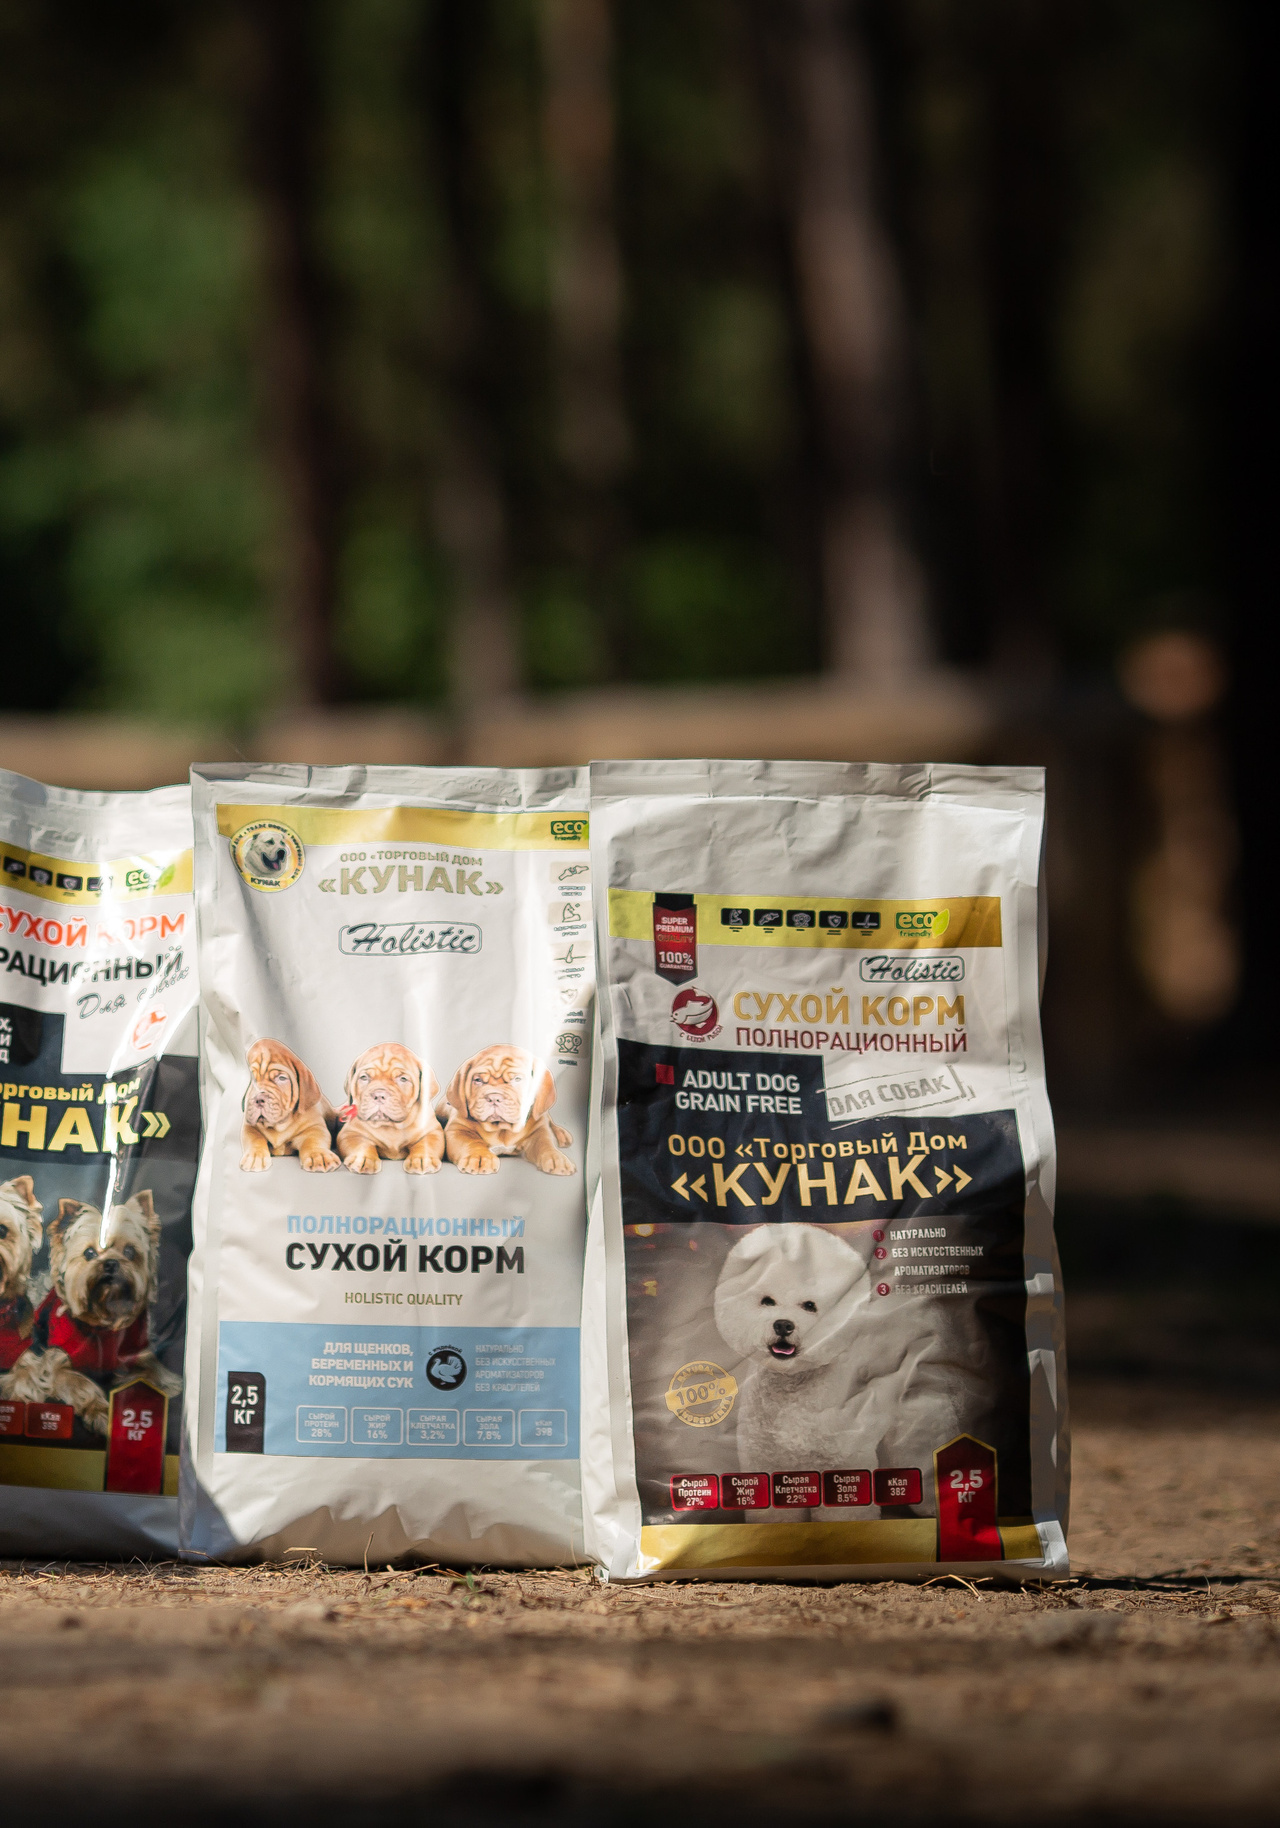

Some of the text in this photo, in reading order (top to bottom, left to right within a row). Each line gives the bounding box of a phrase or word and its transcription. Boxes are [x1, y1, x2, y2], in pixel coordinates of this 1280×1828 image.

[552, 821, 585, 835] eco
[340, 852, 367, 863] ООО
[451, 853, 483, 867] ДОМ
[318, 865, 504, 896] «КУНАК»
[661, 916, 689, 925] SUPER
[897, 913, 934, 928] eco
[655, 924, 694, 934] PREMIUM
[898, 929, 932, 939] friendly
[348, 922, 477, 953] Holistic
[657, 933, 695, 944] QUALITY
[658, 951, 694, 965] 100%
[865, 955, 962, 982] Holistic
[732, 986, 966, 1027] СУХОЙ КОРМ
[0, 1034, 12, 1047] И
[735, 1026, 968, 1055] ПОЛНОРАЦИОННЫЙ
[682, 1069, 800, 1094] ADULT DOG
[97, 1077, 142, 1106] Дом
[876, 1074, 952, 1103] СОБАК
[674, 1092, 803, 1116] GRAIN FREE
[667, 1131, 969, 1165] ООО «Торговый Дом
[670, 1154, 974, 1208] «КУНАК»
[286, 1214, 526, 1240] ПОЛНОРАЦИОННЫЙ
[889, 1227, 947, 1241] НАТУРАЛЬНО
[285, 1238, 525, 1274] СУХОЙ КОРМ
[891, 1246, 984, 1258] БЕЗ ИСКУССТВЕННЫХ
[894, 1264, 970, 1277] АРОМАТИЗАТОРОВ
[895, 1281, 969, 1296] БЕЗ КРАСИТЕЛЕЙ
[344, 1292, 463, 1307] HOLISTIC QUALITY
[323, 1341, 415, 1357] ДЛЯ ЩЕНКОВ,
[475, 1344, 525, 1354] НАТУРАЛЬНО
[311, 1357, 414, 1372] БЕРЕМЕННЫХ И
[475, 1357, 557, 1367] БЕЗ ИСКУССТВЕННЫХ
[475, 1370, 545, 1380] АРОМАТИЗАТОРОВ
[676, 1363, 716, 1384] NATURAL
[308, 1374, 414, 1390] КОРМЯЩИХ СУК
[475, 1383, 541, 1393] БЕЗ КРАСИТЕЛЕЙ
[230, 1384, 259, 1408] 2,5
[674, 1381, 726, 1406] 100%
[121, 1408, 154, 1430] 2,5
[233, 1409, 256, 1425] КГ
[307, 1412, 336, 1421] СЫРОЙ
[363, 1413, 391, 1422] СЫРОЙ
[419, 1415, 447, 1423] СЫРАЯ
[475, 1415, 503, 1423] СЫРАЯ
[304, 1420, 340, 1429] ПРОТЕИН
[367, 1422, 387, 1430] ЖИР
[410, 1422, 456, 1430] КЛЕТЧАТКА
[310, 1428, 333, 1438] 28%
[366, 1429, 388, 1440] 16%
[535, 1427, 553, 1437] 398
[681, 1478, 709, 1488] Сырой
[731, 1477, 759, 1487] Сырой
[782, 1475, 810, 1485] Сырая
[833, 1474, 861, 1484] Сырая
[887, 1477, 908, 1487] кКал
[949, 1468, 984, 1491] 2,5
[677, 1487, 712, 1498] Протеин
[736, 1487, 755, 1497] Жир
[775, 1484, 818, 1494] Клетчатка
[836, 1484, 858, 1493] Зола
[889, 1486, 906, 1497] 382
[686, 1497, 705, 1507] 27%
[736, 1496, 756, 1506] 16%
